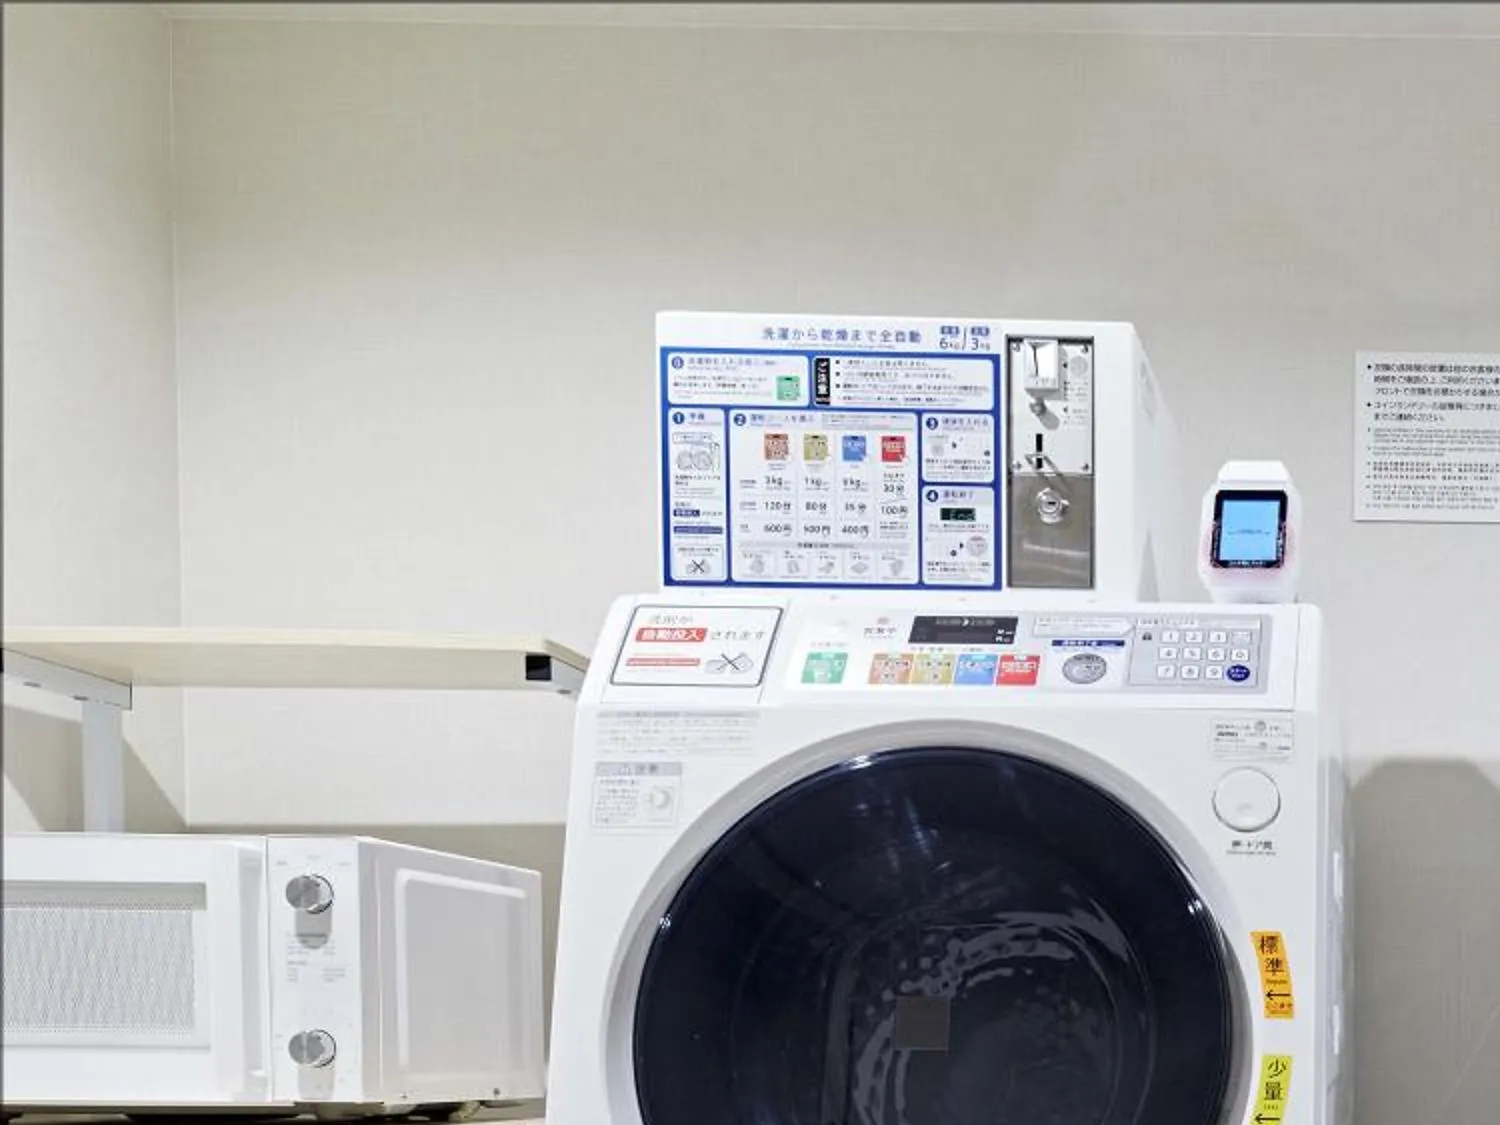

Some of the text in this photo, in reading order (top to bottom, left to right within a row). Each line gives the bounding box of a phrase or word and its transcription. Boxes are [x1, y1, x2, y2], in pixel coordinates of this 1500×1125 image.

[762, 326, 922, 344] 洗濯から乾燥まで全自動
[1259, 934, 1285, 976] 標準
[1264, 1058, 1287, 1101] 少量
